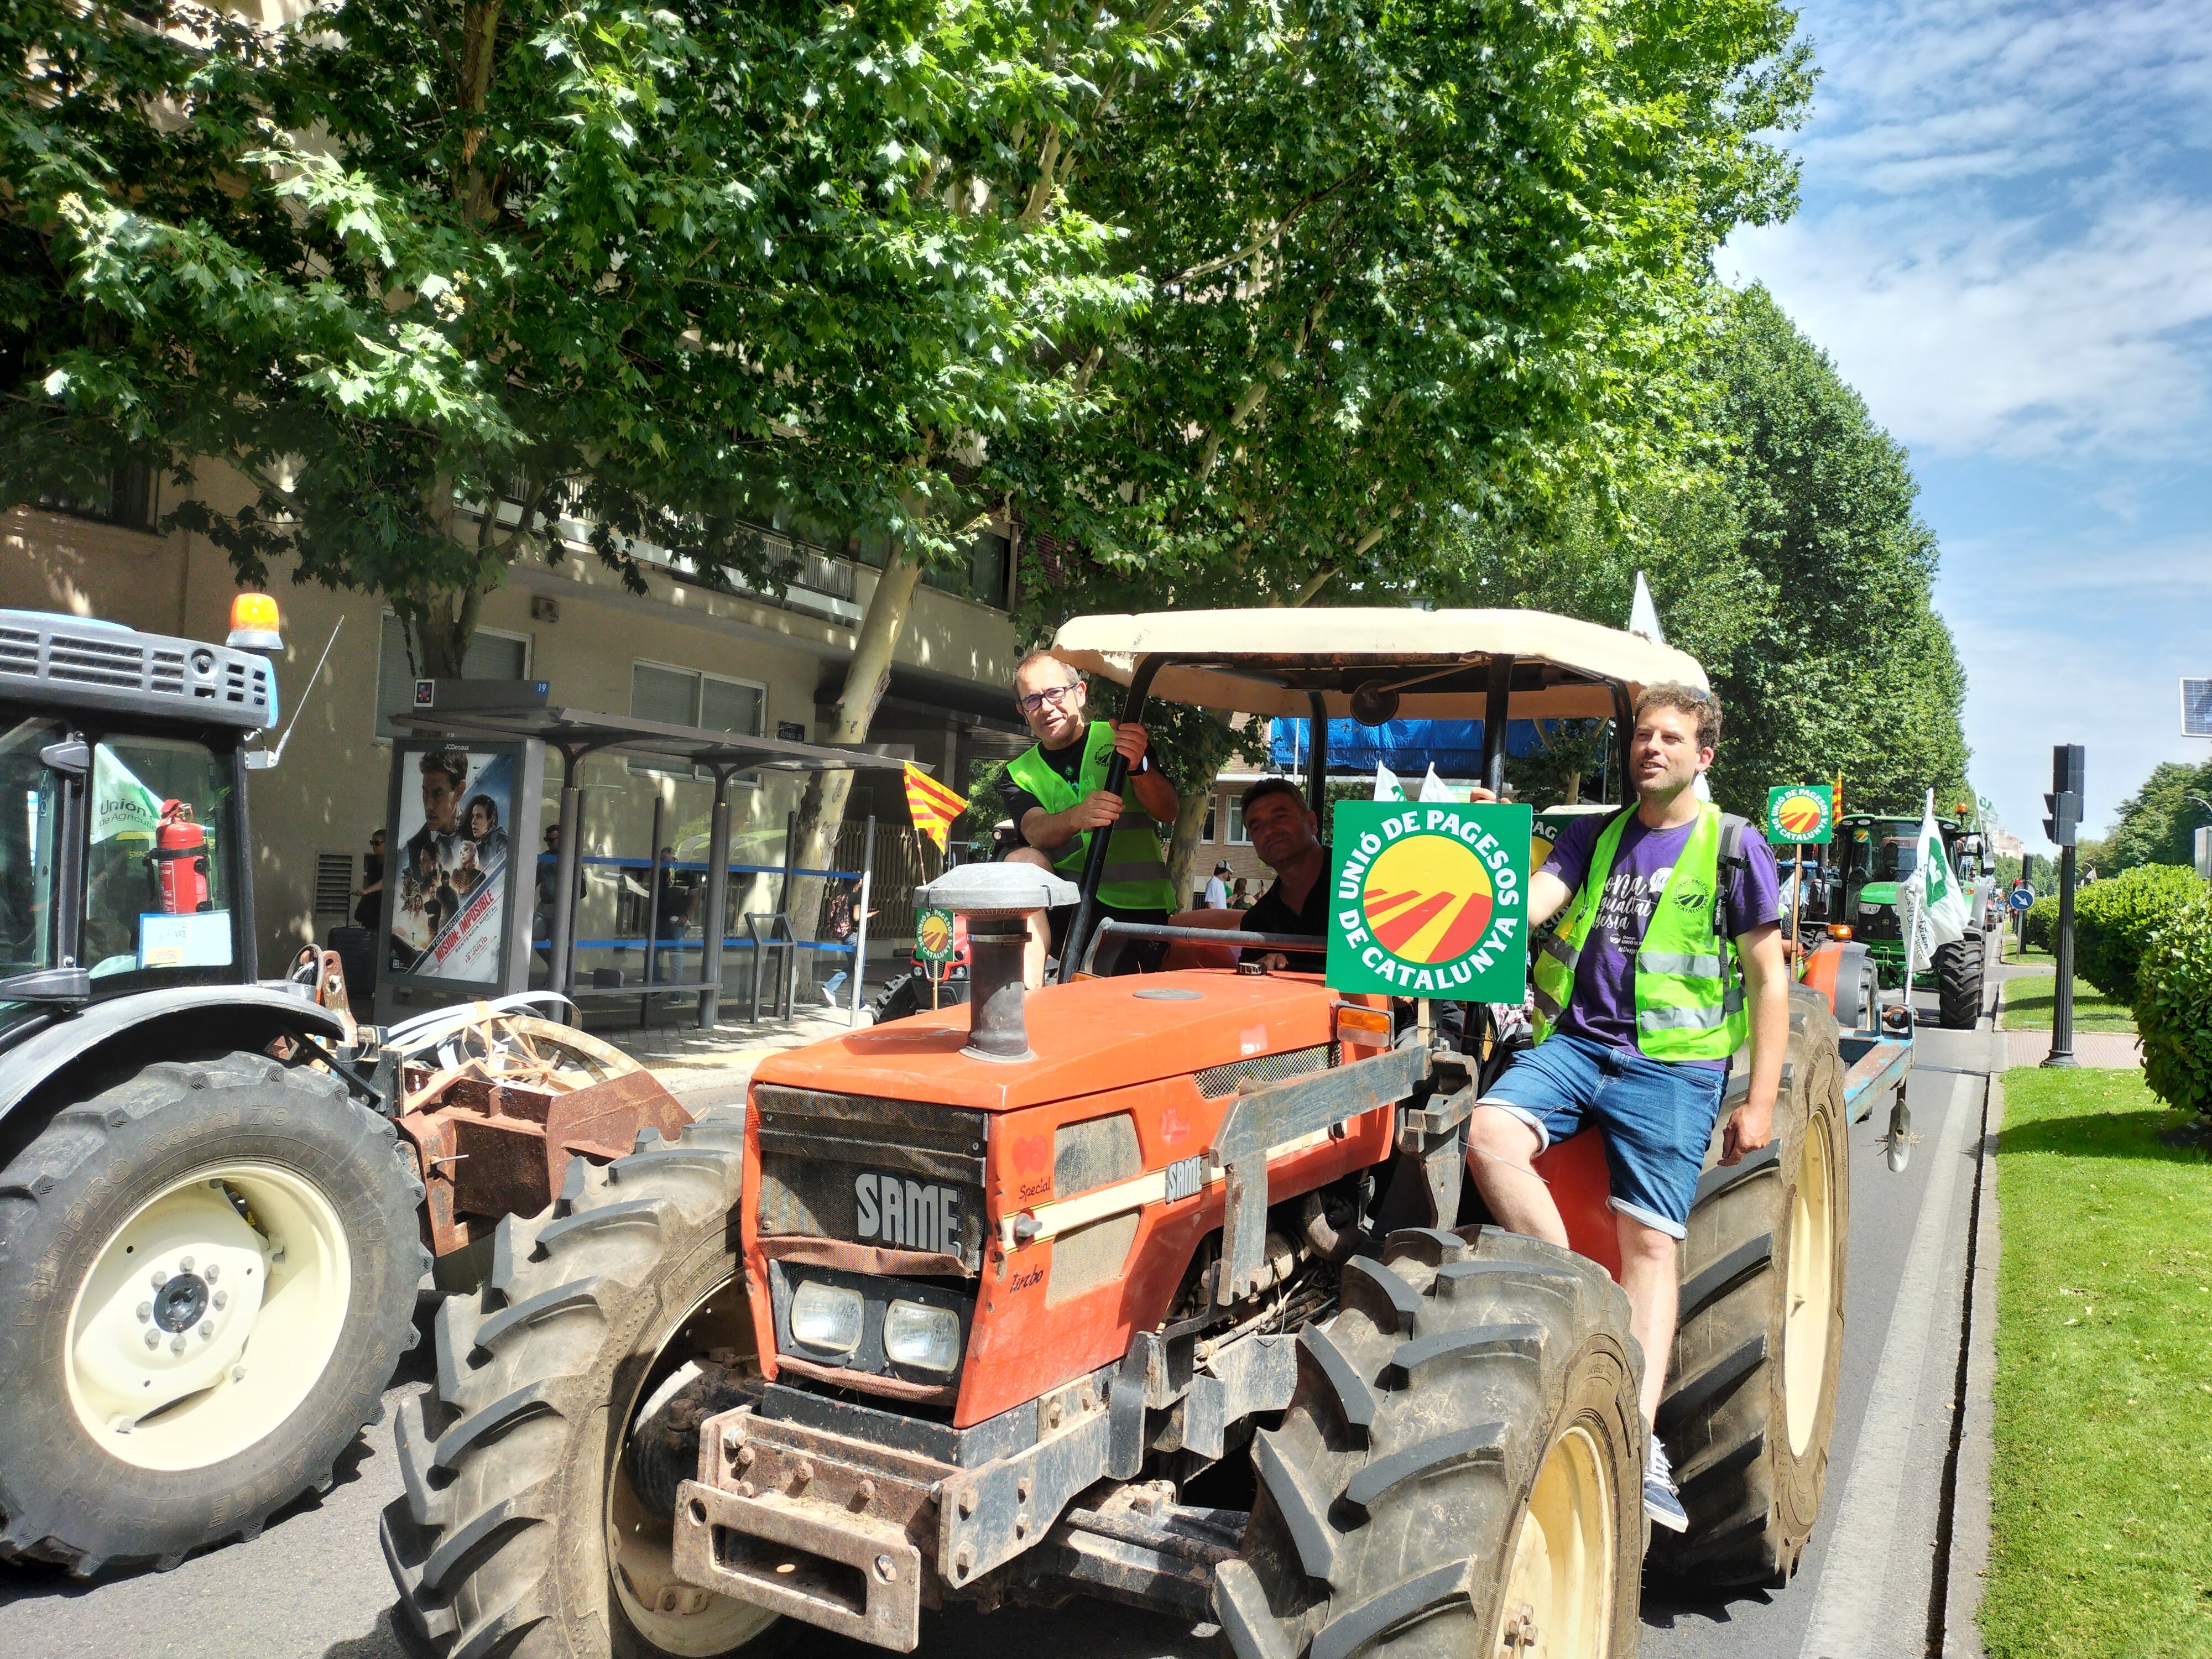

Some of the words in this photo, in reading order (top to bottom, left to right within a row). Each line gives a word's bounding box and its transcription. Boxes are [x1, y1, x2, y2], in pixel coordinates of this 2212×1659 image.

[538, 684, 546, 692] 19
[100, 799, 146, 817] Unión
[1771, 796, 1785, 816] UNIÓ
[1785, 789, 1797, 799] DE
[1798, 789, 1829, 816] PAGESOS
[99, 816, 110, 827] de
[111, 812, 158, 832] Agriculto
[1771, 818, 1782, 830] DE
[1779, 818, 1828, 841] CATALUNYA
[1338, 831, 1381, 899] UNIÓ
[1381, 810, 1421, 840] DE
[1426, 810, 1519, 906] PAGESOS
[1605, 874, 1647, 899] ona
[1691, 879, 1709, 897] PAGESOS
[458, 889, 494, 935] IMPOSIBLE
[1678, 899, 1708, 914] CATALUNYA
[432, 933, 445, 948] TOM
[445, 908, 466, 934] CRUISE
[455, 925, 479, 953] SENTENCIA
[479, 905, 498, 925] MORTAL
[918, 914, 927, 933] UNIÓ
[934, 909, 953, 937] PAGESOS
[472, 936, 488, 956] JULIO
[918, 936, 925, 947] DE
[922, 939, 952, 959] CATALUNYA
[1338, 909, 1369, 950] DE
[1362, 918, 1518, 990] CATALUNYA
[139, 1106, 239, 1160] Radial
[249, 1104, 290, 1128] 70
[1019, 1177, 1051, 1202] Special
[1168, 1155, 1202, 1202] SAME
[855, 1173, 959, 1257] SAME
[208, 1371, 376, 1530] ALLIANCE
